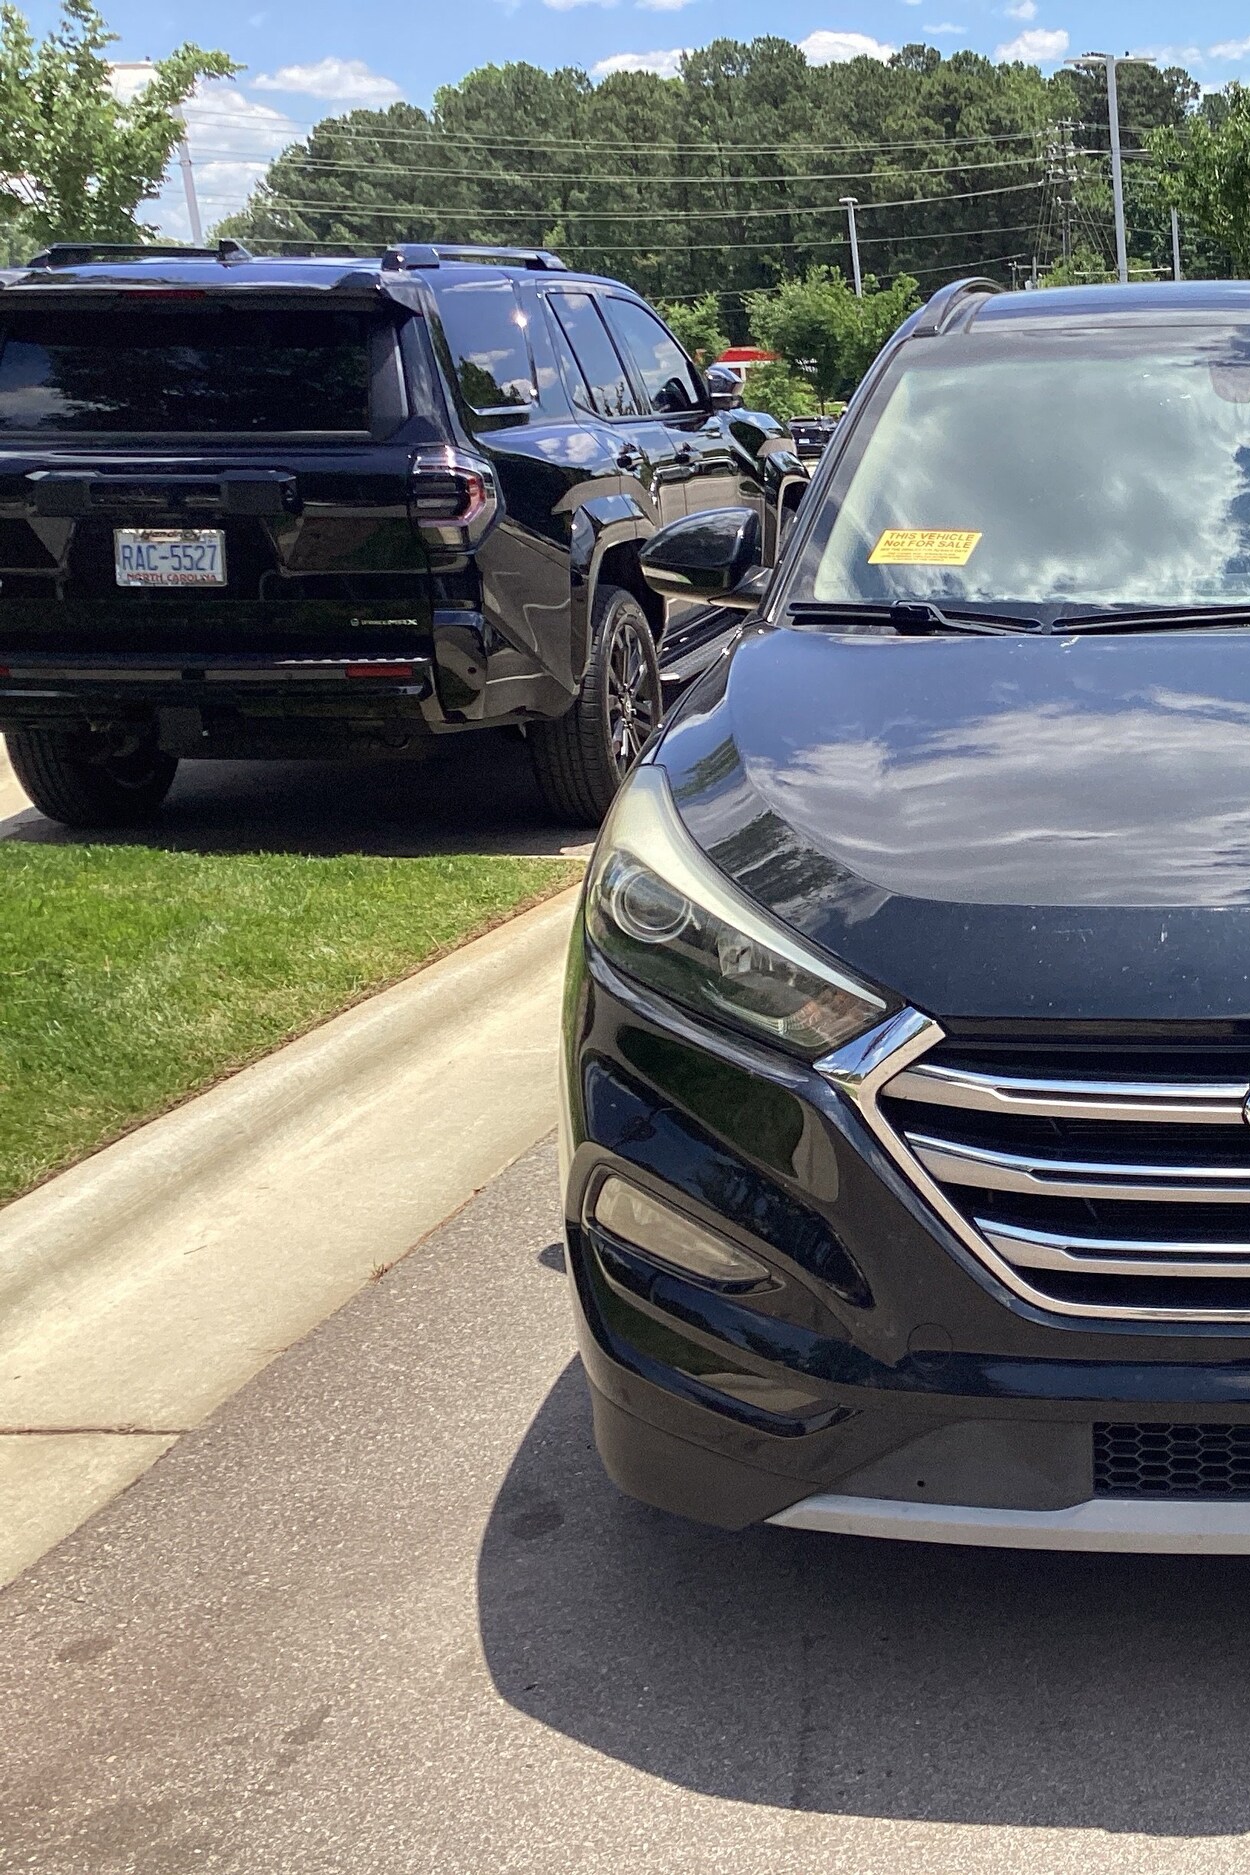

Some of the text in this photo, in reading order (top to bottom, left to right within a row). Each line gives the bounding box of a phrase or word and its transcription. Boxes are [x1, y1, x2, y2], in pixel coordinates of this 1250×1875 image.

[888, 532, 976, 542] THIS VEHICLE
[907, 540, 935, 548] FOR
[937, 541, 973, 549] SALE
[121, 544, 217, 571] RAC-5527
[126, 573, 162, 581] NORTH
